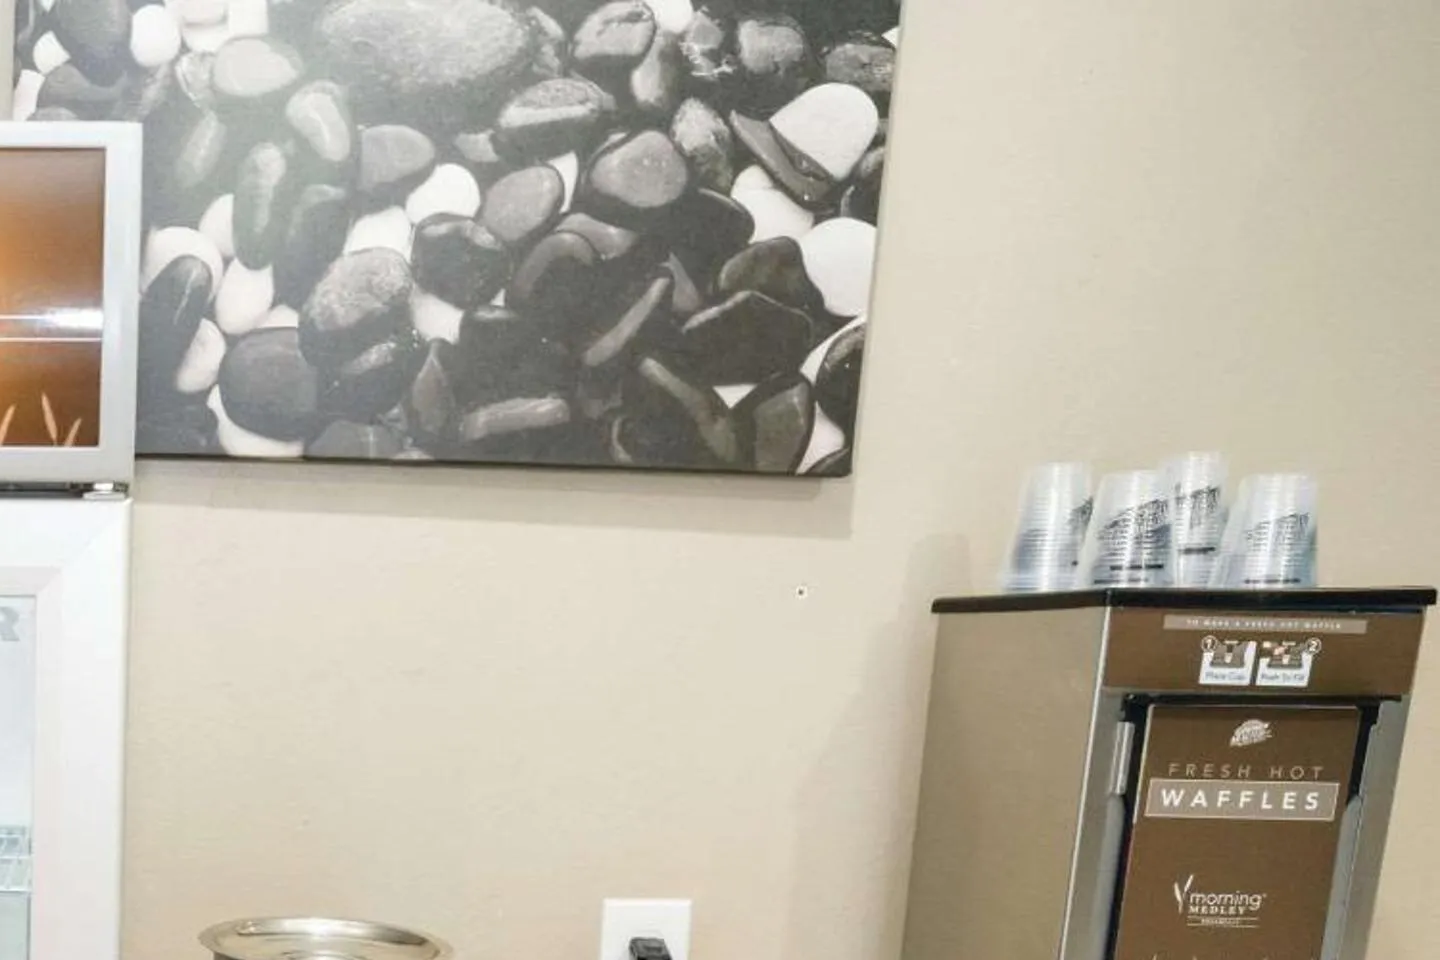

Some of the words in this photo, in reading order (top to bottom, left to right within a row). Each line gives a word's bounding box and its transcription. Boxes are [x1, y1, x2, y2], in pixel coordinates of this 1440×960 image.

[1168, 763, 1251, 779] FRESH
[1269, 766, 1324, 780] HOT
[1160, 788, 1321, 810] WAFFLES
[1188, 905, 1246, 915] MEDLEY
[1189, 890, 1262, 911] morning
